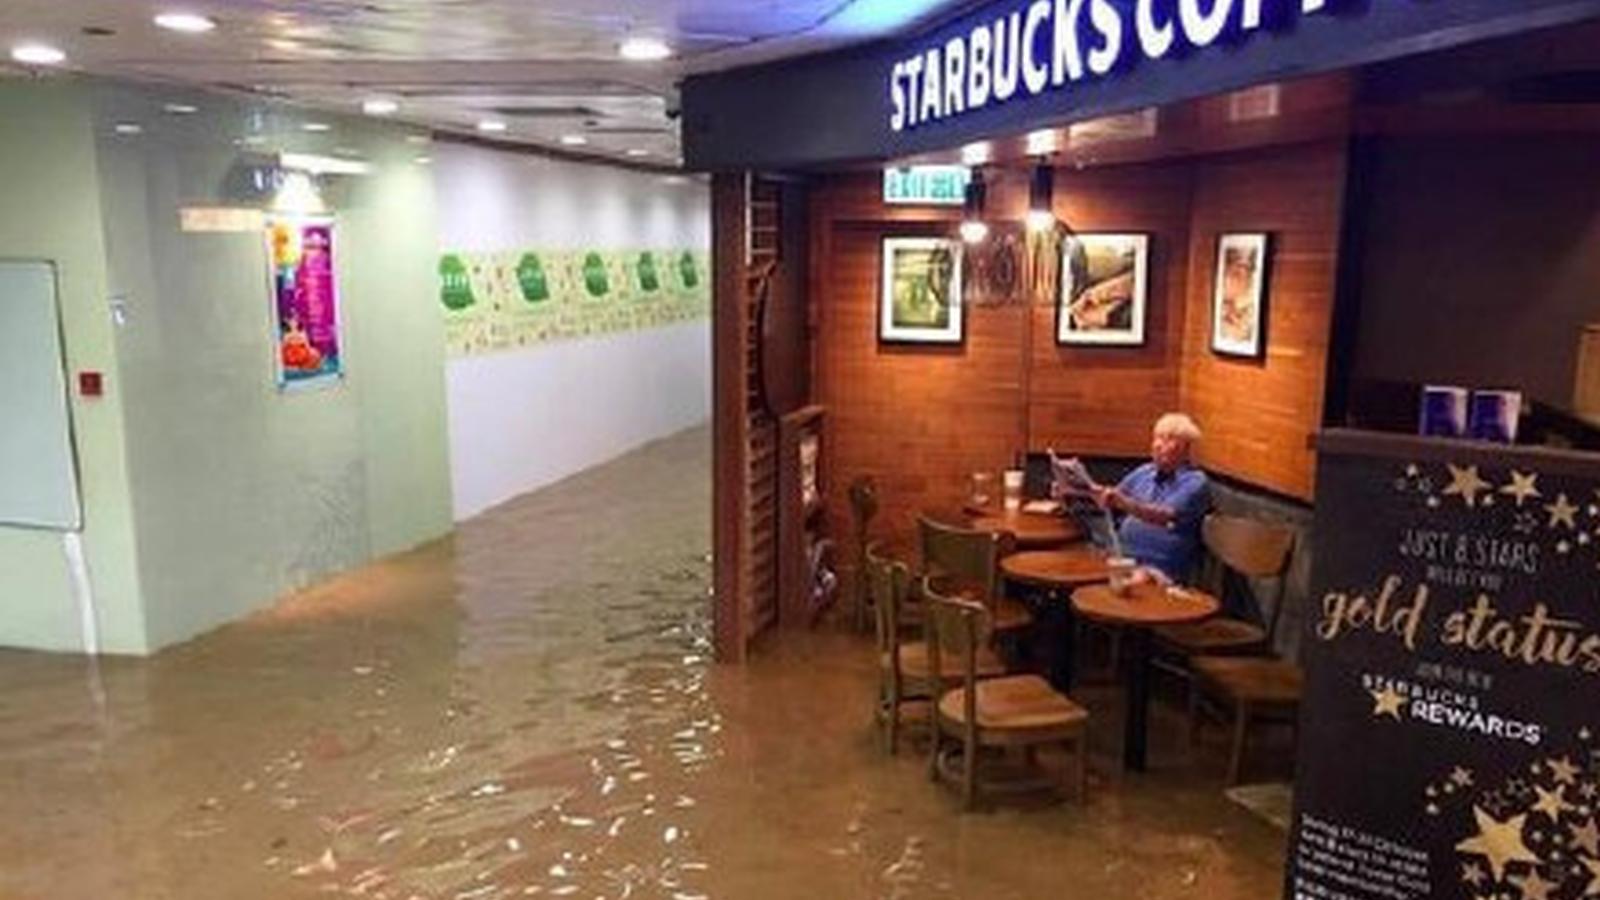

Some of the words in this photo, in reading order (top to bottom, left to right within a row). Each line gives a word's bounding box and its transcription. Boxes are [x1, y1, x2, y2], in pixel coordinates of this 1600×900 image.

[890, 0, 1121, 131] STARBUCKS
[1400, 529, 1449, 559] JUST
[1472, 535, 1540, 574] STARS
[1316, 574, 1430, 650] gold
[1440, 594, 1600, 672] status
[1410, 700, 1542, 746] REWARDS
